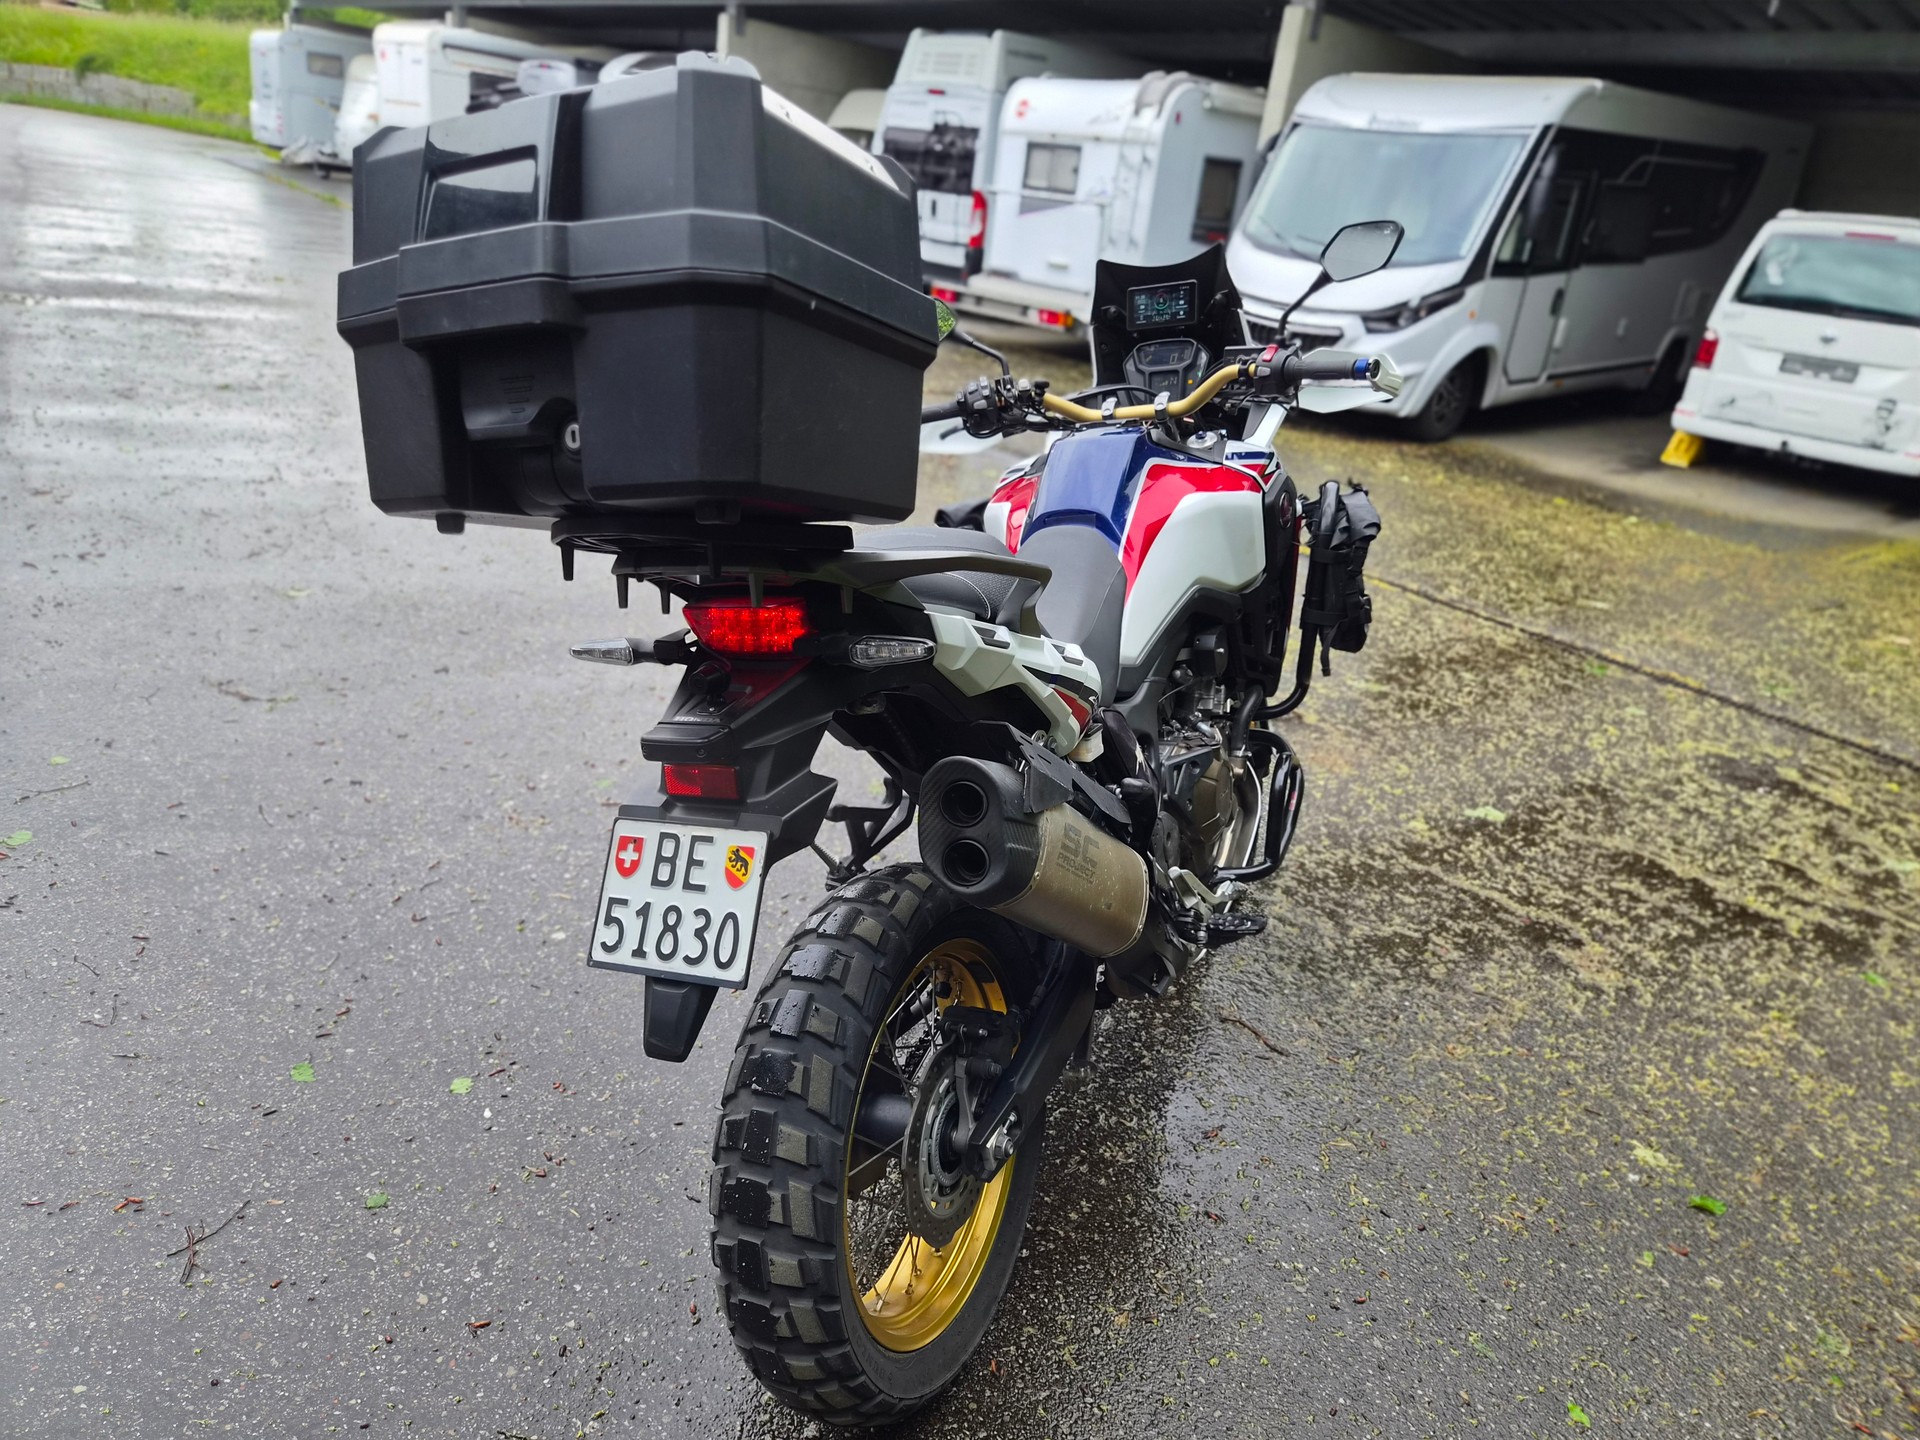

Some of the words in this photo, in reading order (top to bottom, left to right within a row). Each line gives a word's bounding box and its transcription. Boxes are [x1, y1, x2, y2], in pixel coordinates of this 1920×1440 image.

[673, 716, 720, 724] HONDA
[650, 831, 714, 892] BE
[1057, 851, 1096, 879] PROJECT
[600, 896, 740, 970] 51830
